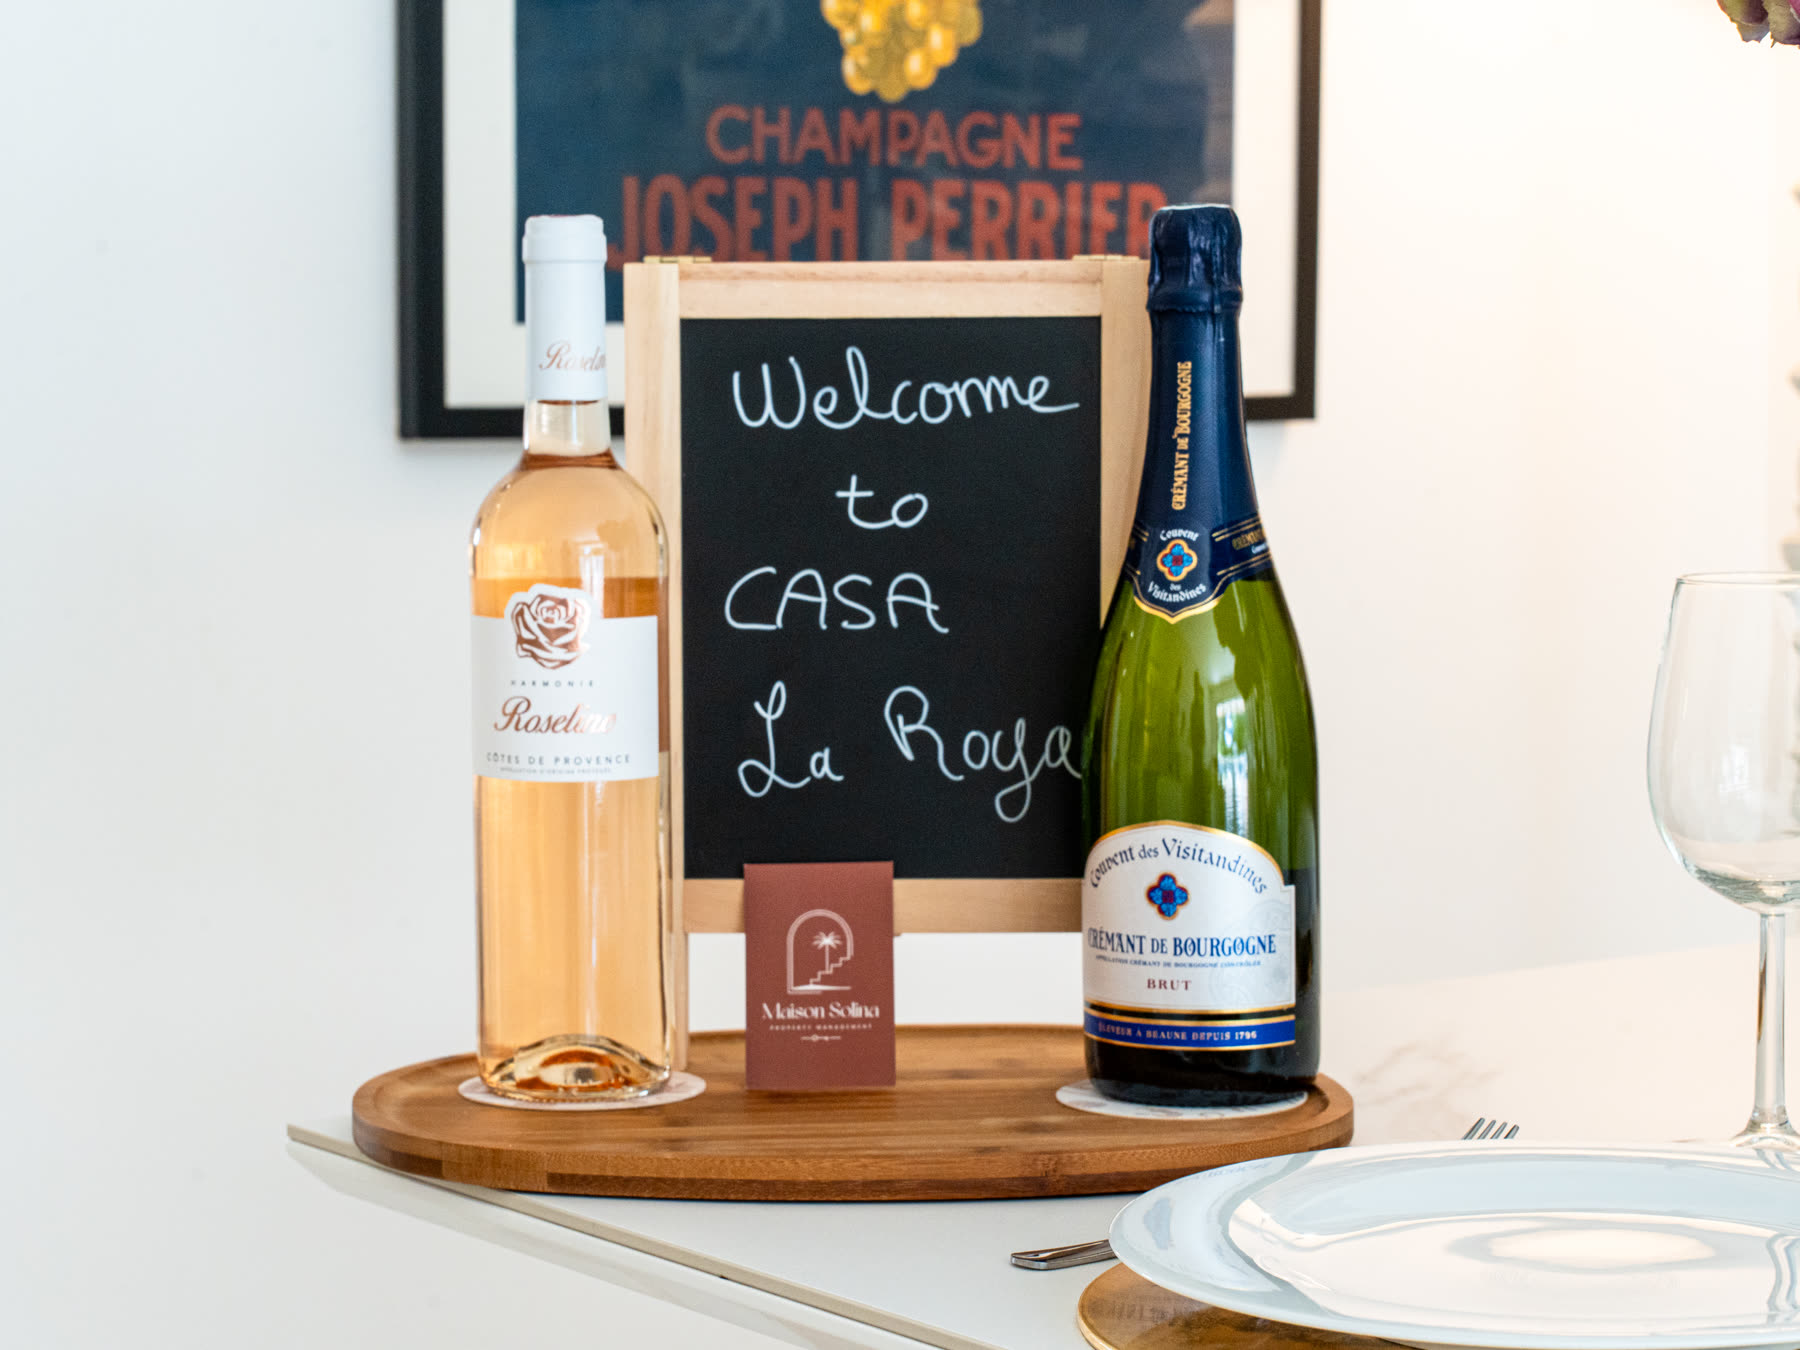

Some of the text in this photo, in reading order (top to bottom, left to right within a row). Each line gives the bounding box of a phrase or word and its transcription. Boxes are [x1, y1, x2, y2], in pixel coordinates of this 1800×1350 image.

[706, 104, 1083, 170] CHAMPAGNE
[607, 174, 859, 271] JOSEPH
[732, 346, 1080, 430] Welcome
[1172, 361, 1192, 511] CRÉMANT DE BOURGOGNE
[835, 474, 929, 529] to
[1160, 529, 1199, 542] Couvent
[725, 566, 949, 633] CASA
[1148, 581, 1206, 602] Visitandines
[486, 751, 630, 766] CÔTES DE PROVENCE
[738, 681, 1083, 823] La Roya
[1090, 837, 1268, 894] Couvent des Visitandines
[1087, 927, 1277, 958] CRÉMANT DE BOURGOGNE
[762, 1001, 880, 1019] Maison Solina
[1147, 978, 1193, 991] BRUT
[1146, 1029, 1187, 1041] BEAUNE
[1191, 1031, 1231, 1041] DEPUIS
